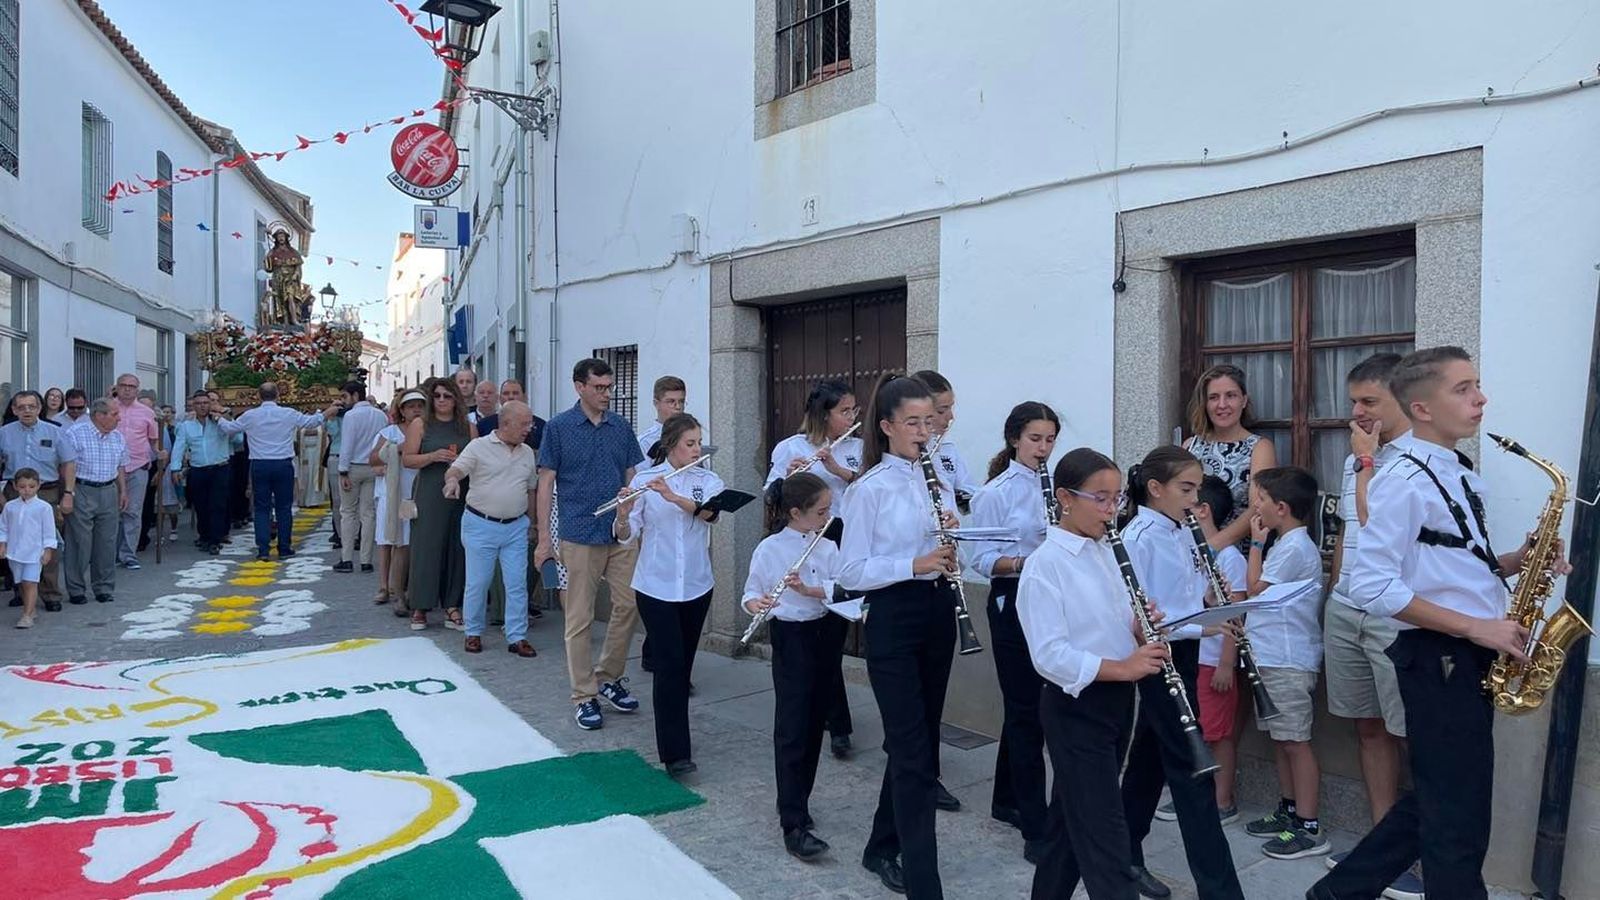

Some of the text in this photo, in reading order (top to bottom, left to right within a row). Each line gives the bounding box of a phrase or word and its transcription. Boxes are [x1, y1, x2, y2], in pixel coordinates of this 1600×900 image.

[392, 174, 459, 197] BAR LA CUEVA
[0, 757, 174, 789] LISBO
